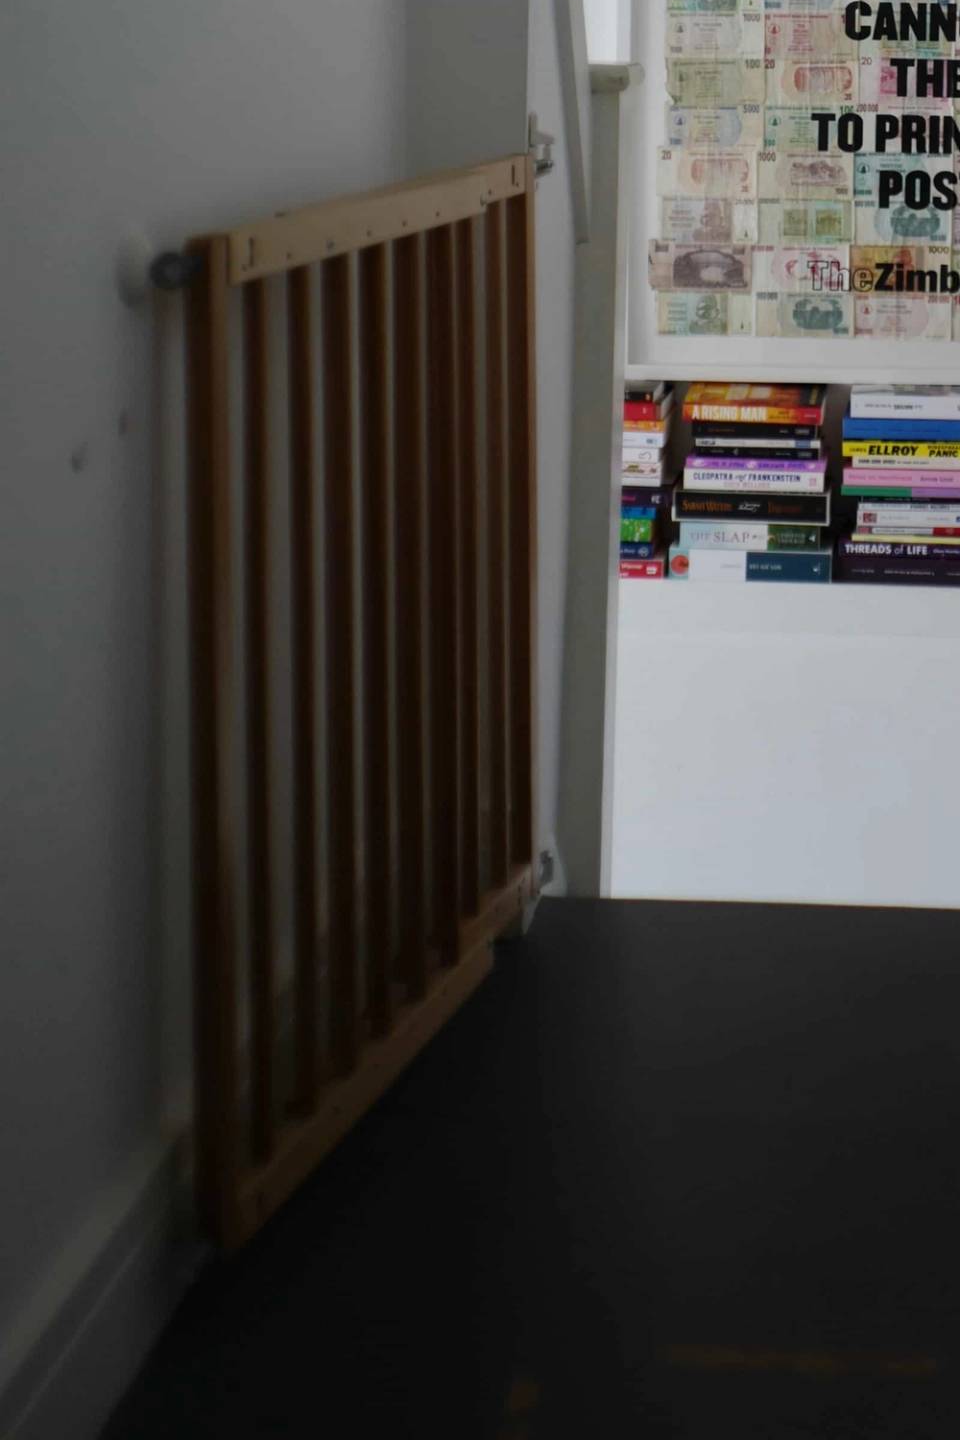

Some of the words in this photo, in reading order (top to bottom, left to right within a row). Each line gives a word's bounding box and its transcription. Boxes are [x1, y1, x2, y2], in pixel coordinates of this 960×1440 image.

[812, 113, 863, 153] TO
[691, 404, 700, 420] A
[701, 404, 738, 422] RISING
[740, 405, 768, 422] MAN
[868, 444, 920, 457] ELLROY
[928, 449, 959, 458] PANIC
[693, 472, 733, 481] CLEOPATRA
[748, 473, 802, 483] FRANKENSTEIN
[713, 531, 750, 544] SLAP
[845, 544, 892, 555] THREADS
[894, 545, 904, 555] of
[907, 545, 929, 556] LIFE
